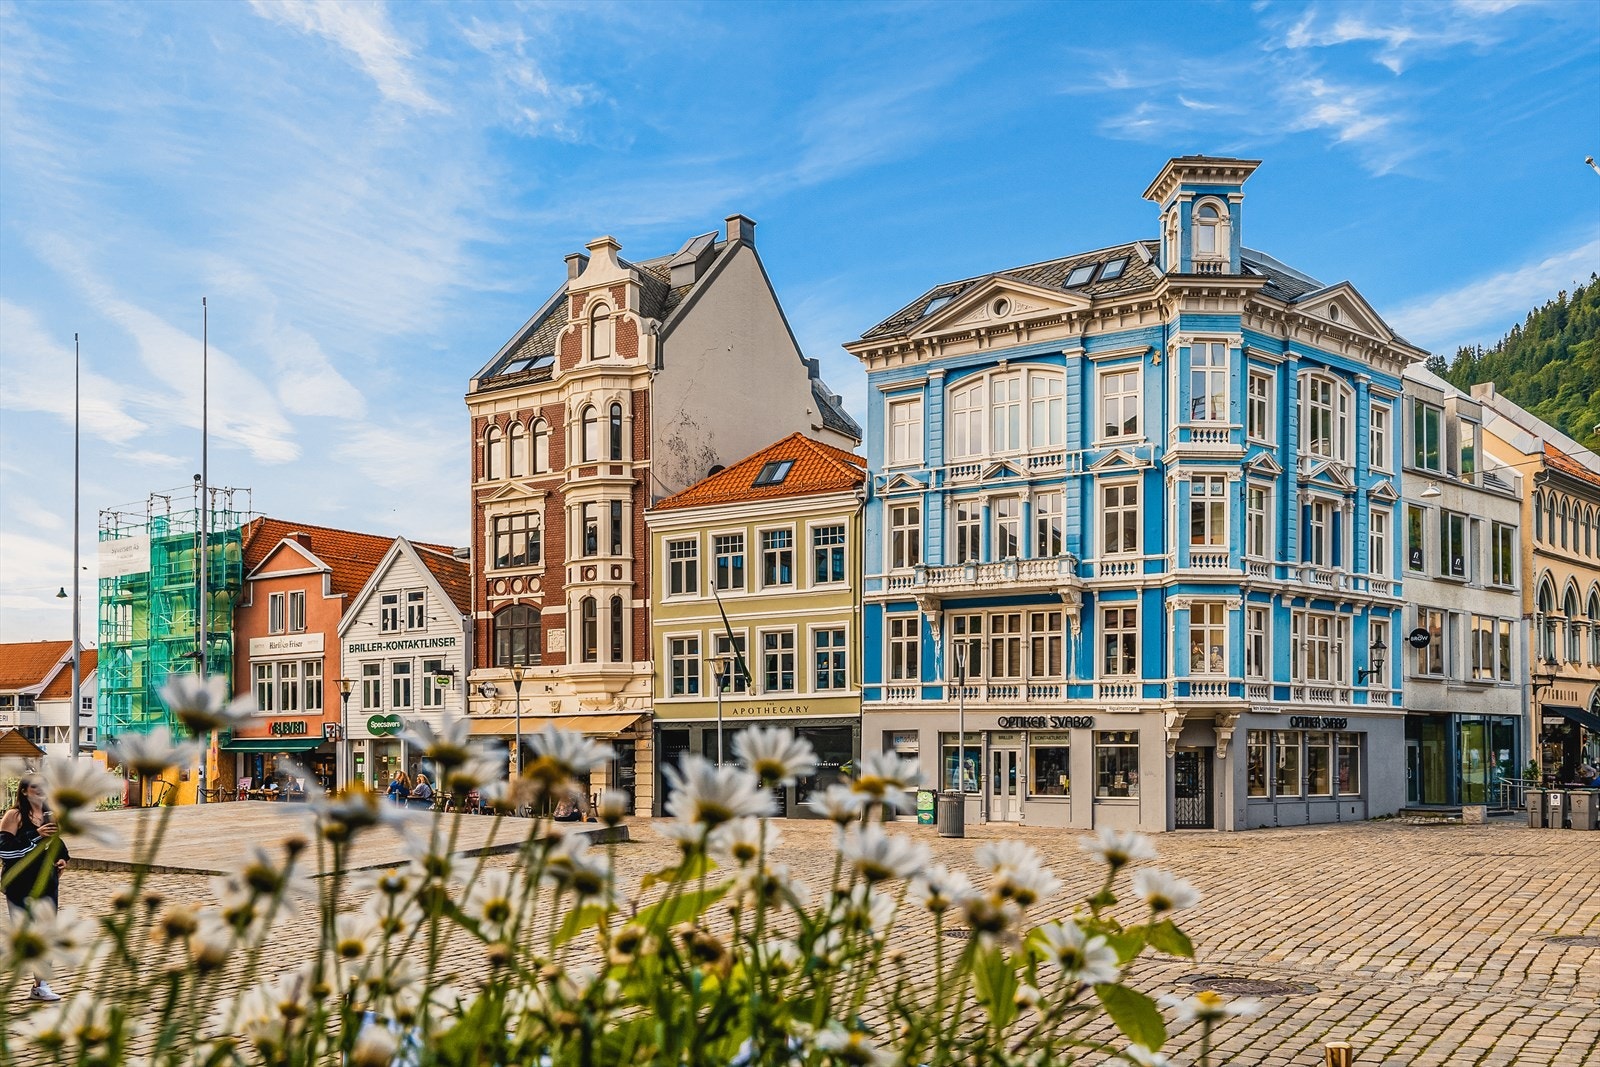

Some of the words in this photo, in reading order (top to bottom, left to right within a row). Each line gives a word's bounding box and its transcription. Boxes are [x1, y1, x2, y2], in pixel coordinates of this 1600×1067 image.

[348, 637, 456, 653] BRILLER-KONTAKTLINSER
[732, 706, 809, 715] APOTHECARY
[370, 720, 400, 729] Specsavers
[997, 715, 1046, 729] OPTIKER
[1049, 715, 1094, 729] SVABØ
[1290, 715, 1320, 729] OPTIKER
[1321, 717, 1348, 729] SVABØ
